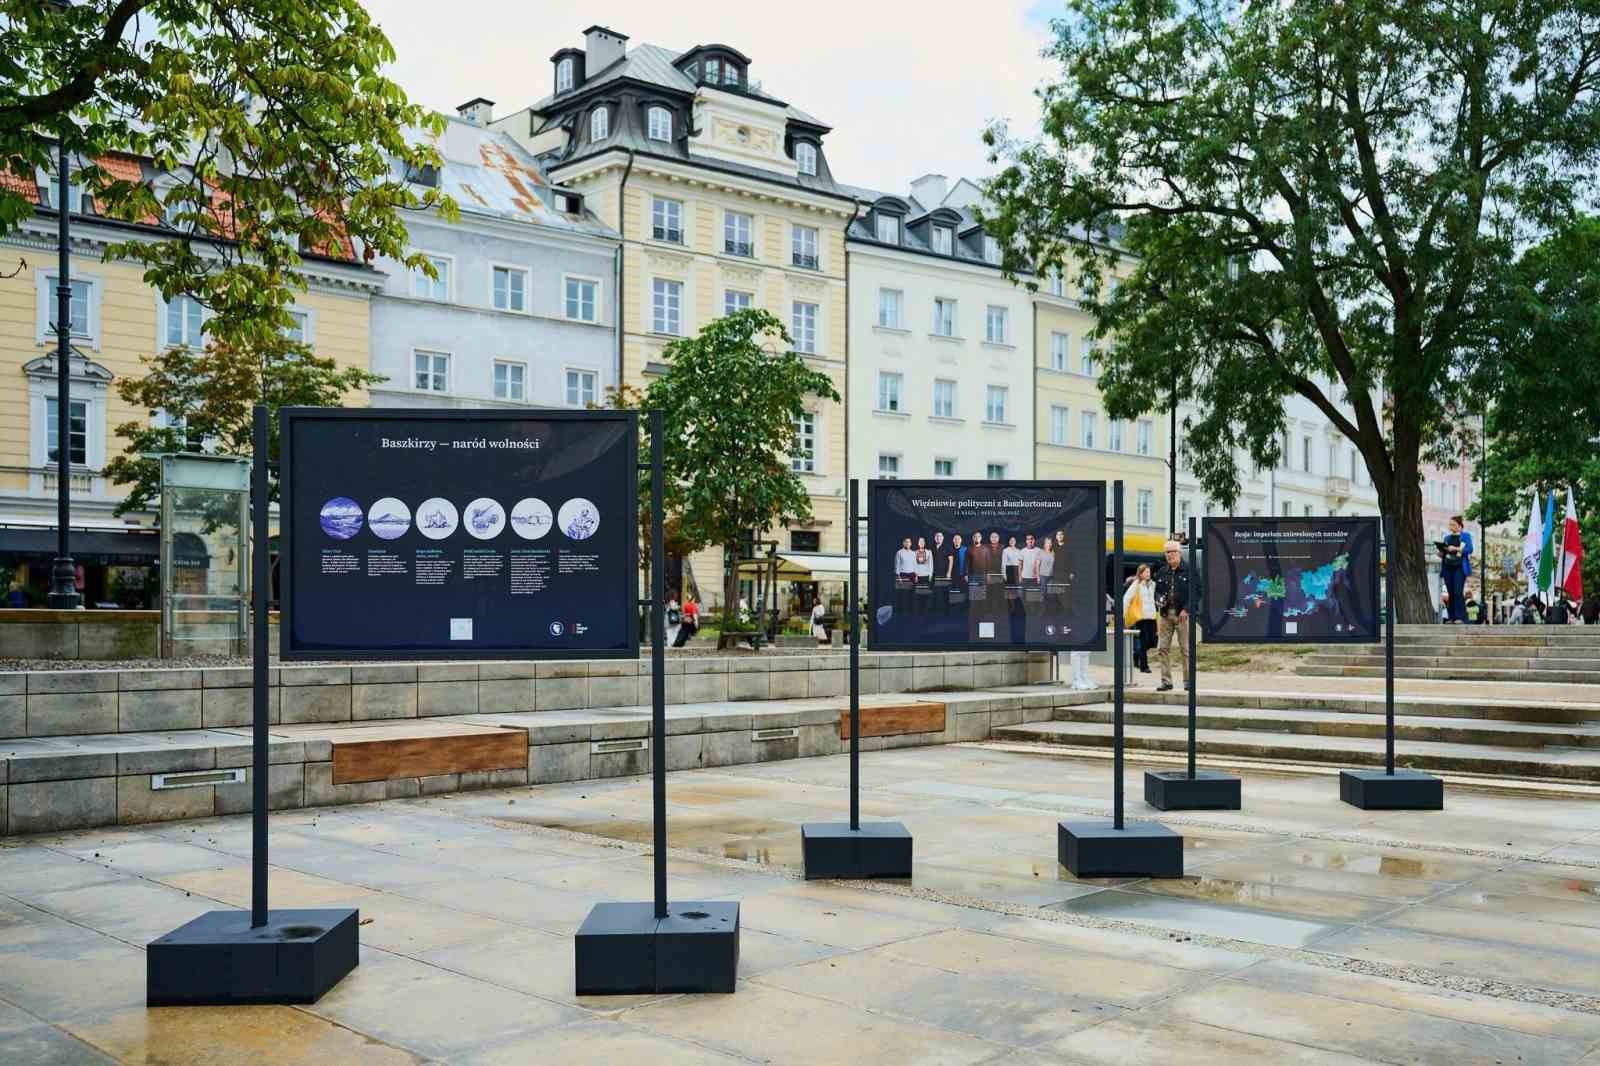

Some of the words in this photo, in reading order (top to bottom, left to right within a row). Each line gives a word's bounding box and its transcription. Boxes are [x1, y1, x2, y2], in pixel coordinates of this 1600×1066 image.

[381, 438, 437, 451] Baszkirzy
[453, 438, 486, 449] naród
[489, 438, 540, 449] wolności
[958, 499, 996, 509] polityczni
